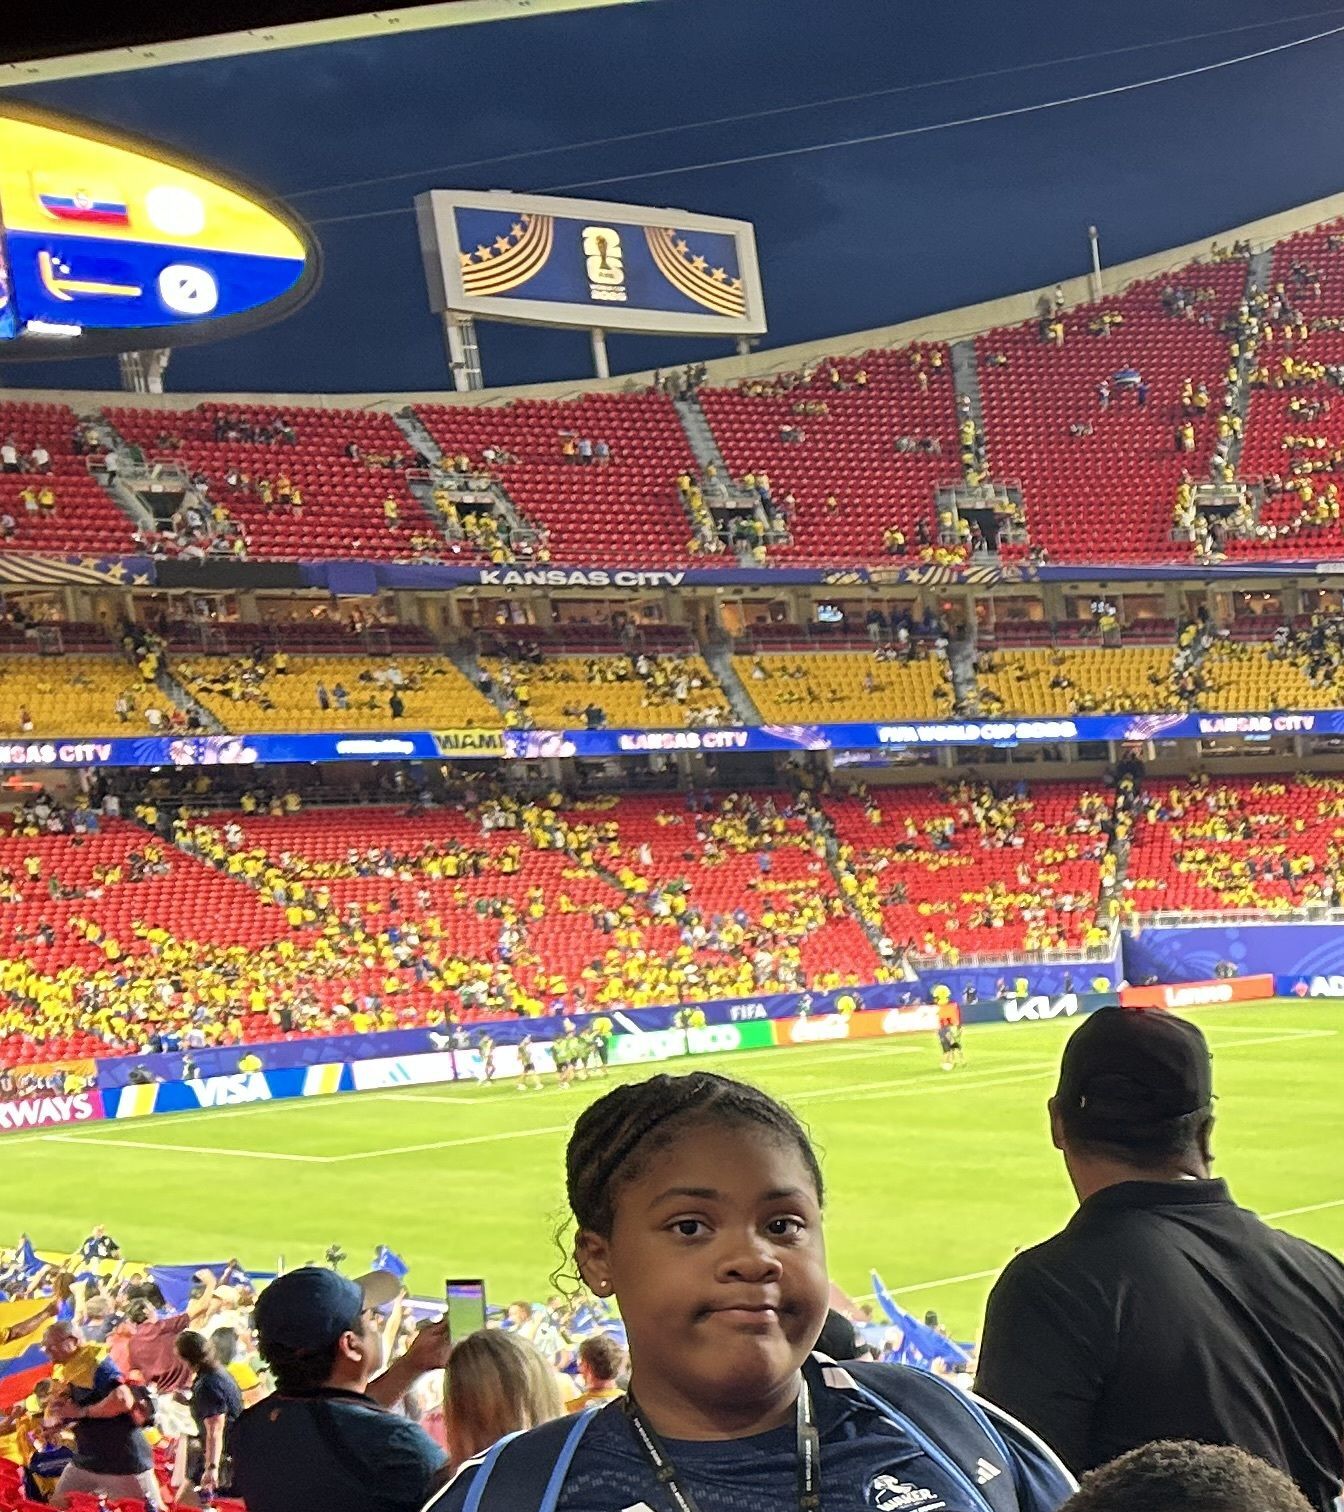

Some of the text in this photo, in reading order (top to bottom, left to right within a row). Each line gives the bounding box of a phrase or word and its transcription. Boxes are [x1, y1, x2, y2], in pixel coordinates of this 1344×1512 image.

[480, 569, 686, 586] KANSAS CITY
[59, 744, 112, 762] CITY
[730, 1003, 767, 1020] FIFA
[186, 1070, 272, 1107] VISA
